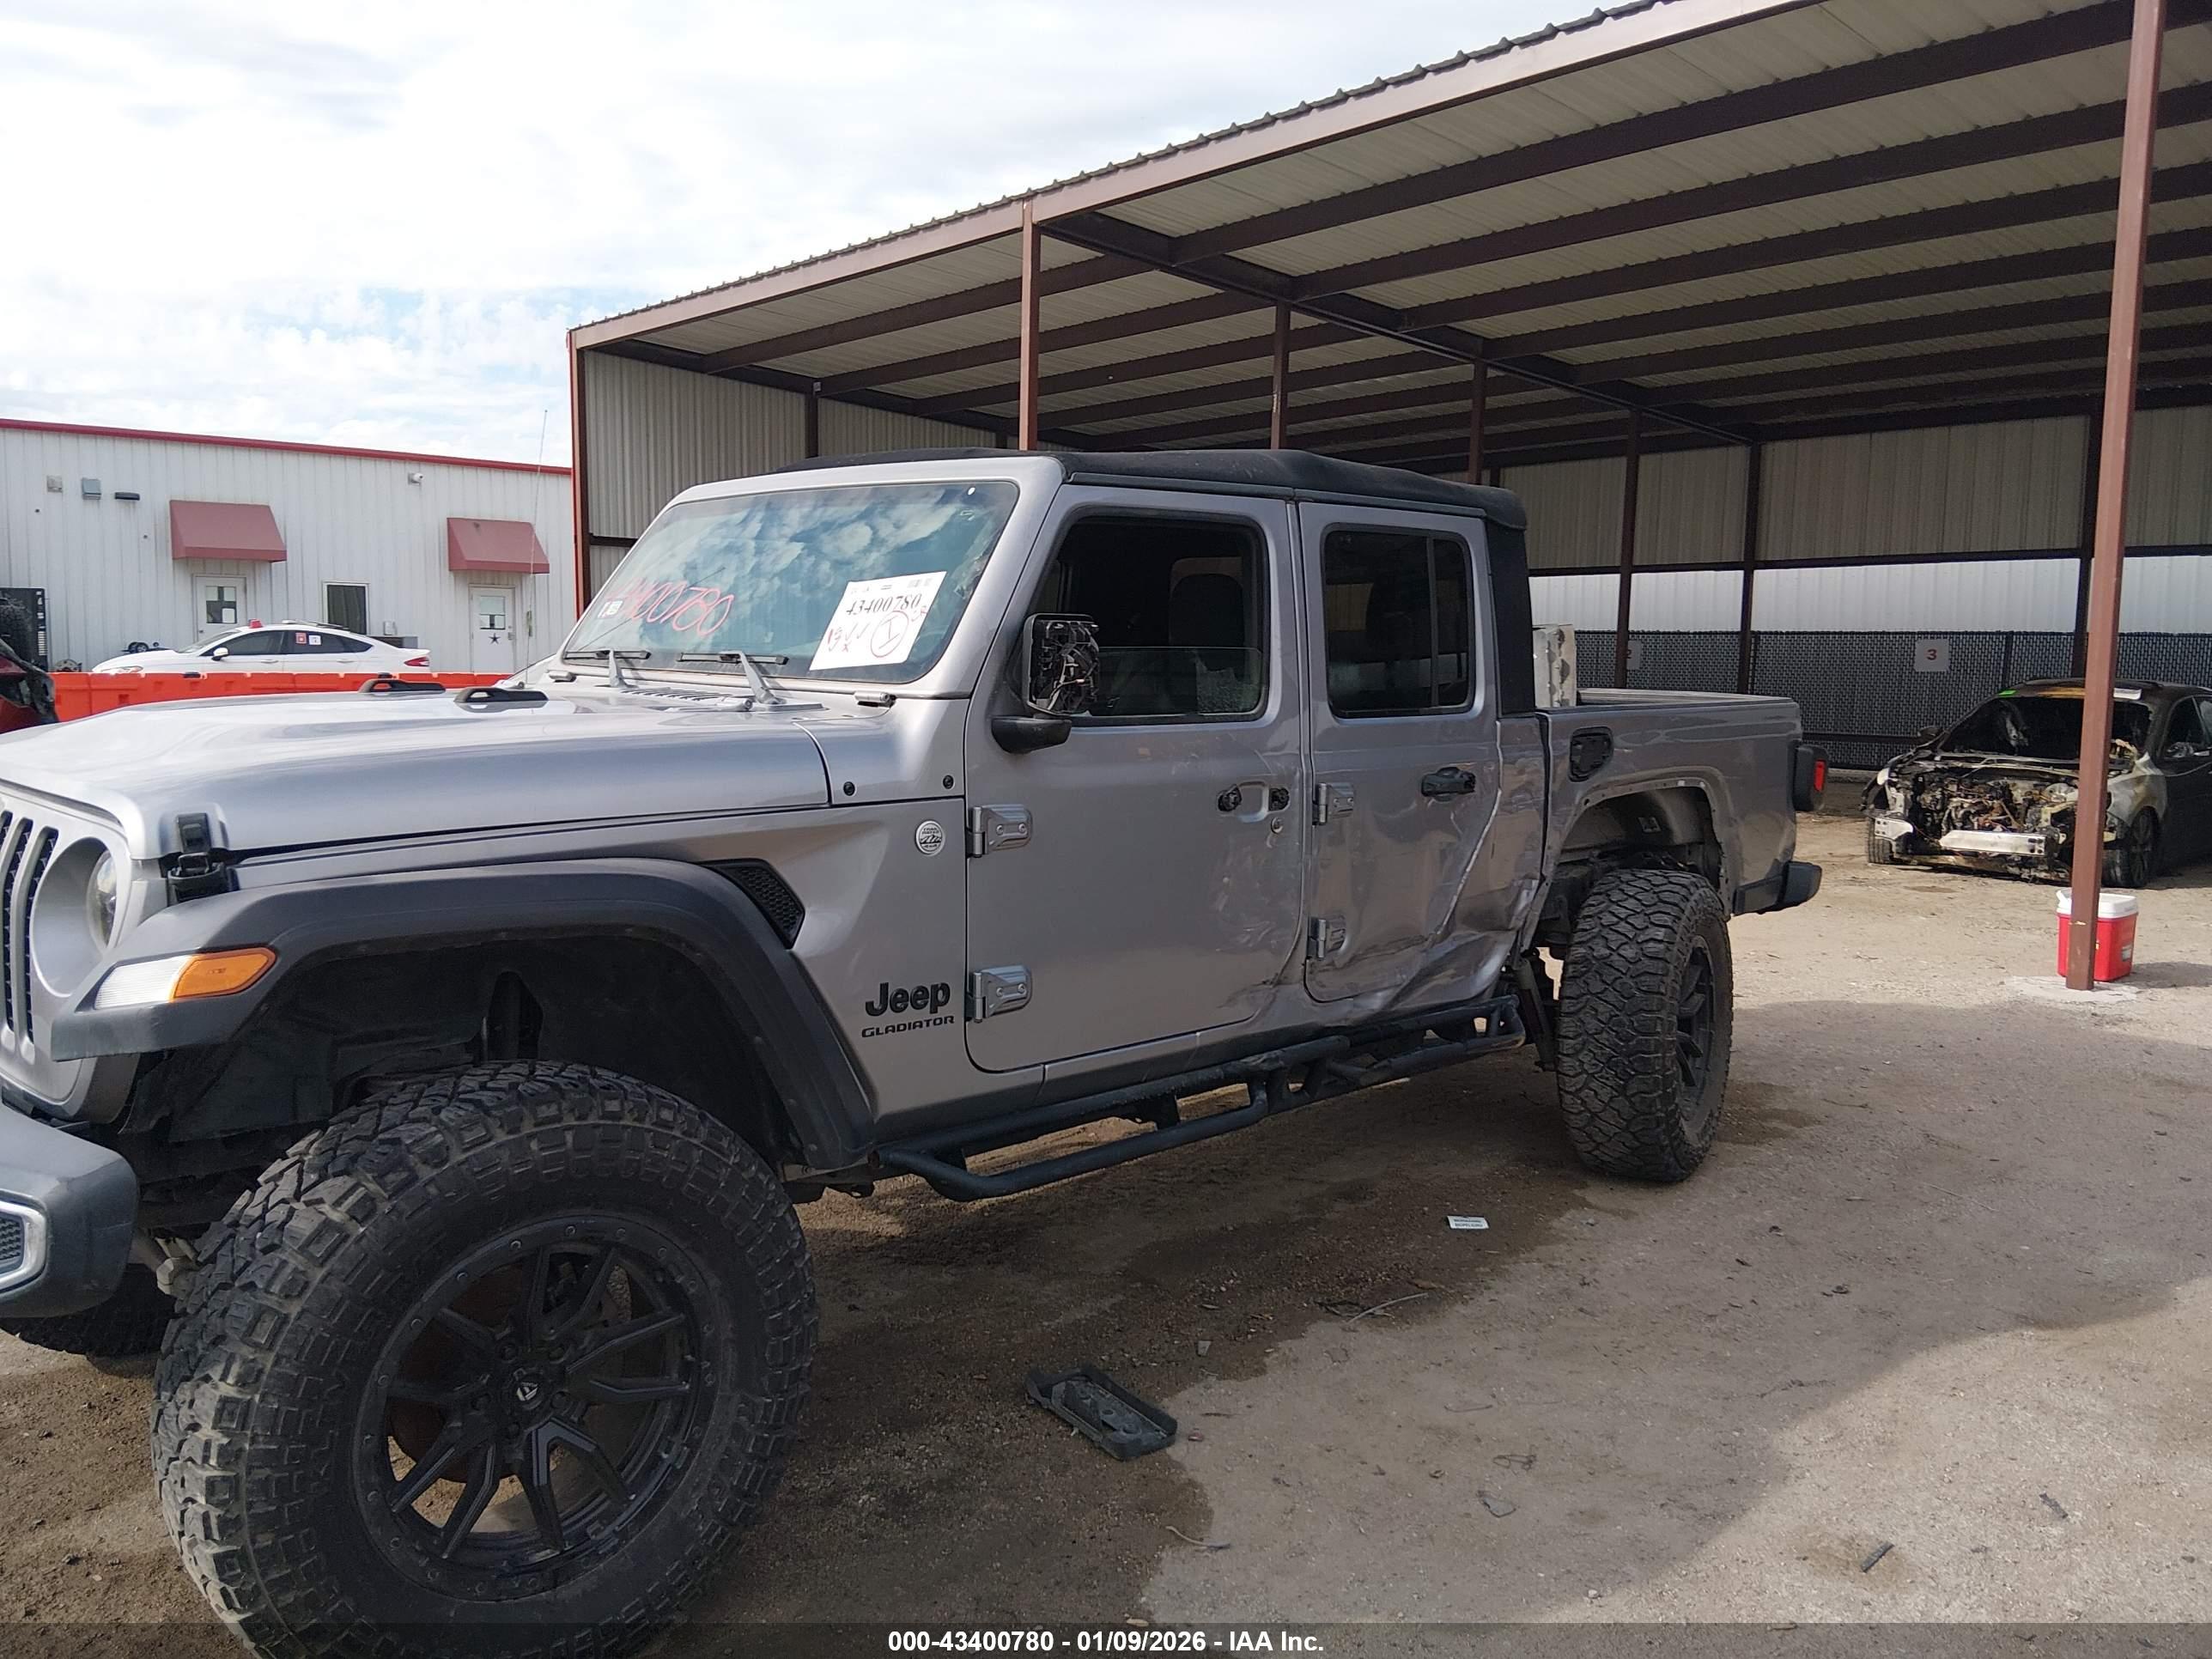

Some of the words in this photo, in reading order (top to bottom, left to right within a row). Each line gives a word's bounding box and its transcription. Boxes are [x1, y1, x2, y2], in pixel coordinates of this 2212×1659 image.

[1927, 648, 1938, 660] 3
[866, 982, 951, 1017] Jeep
[861, 1016, 955, 1037] GLADIATOR
